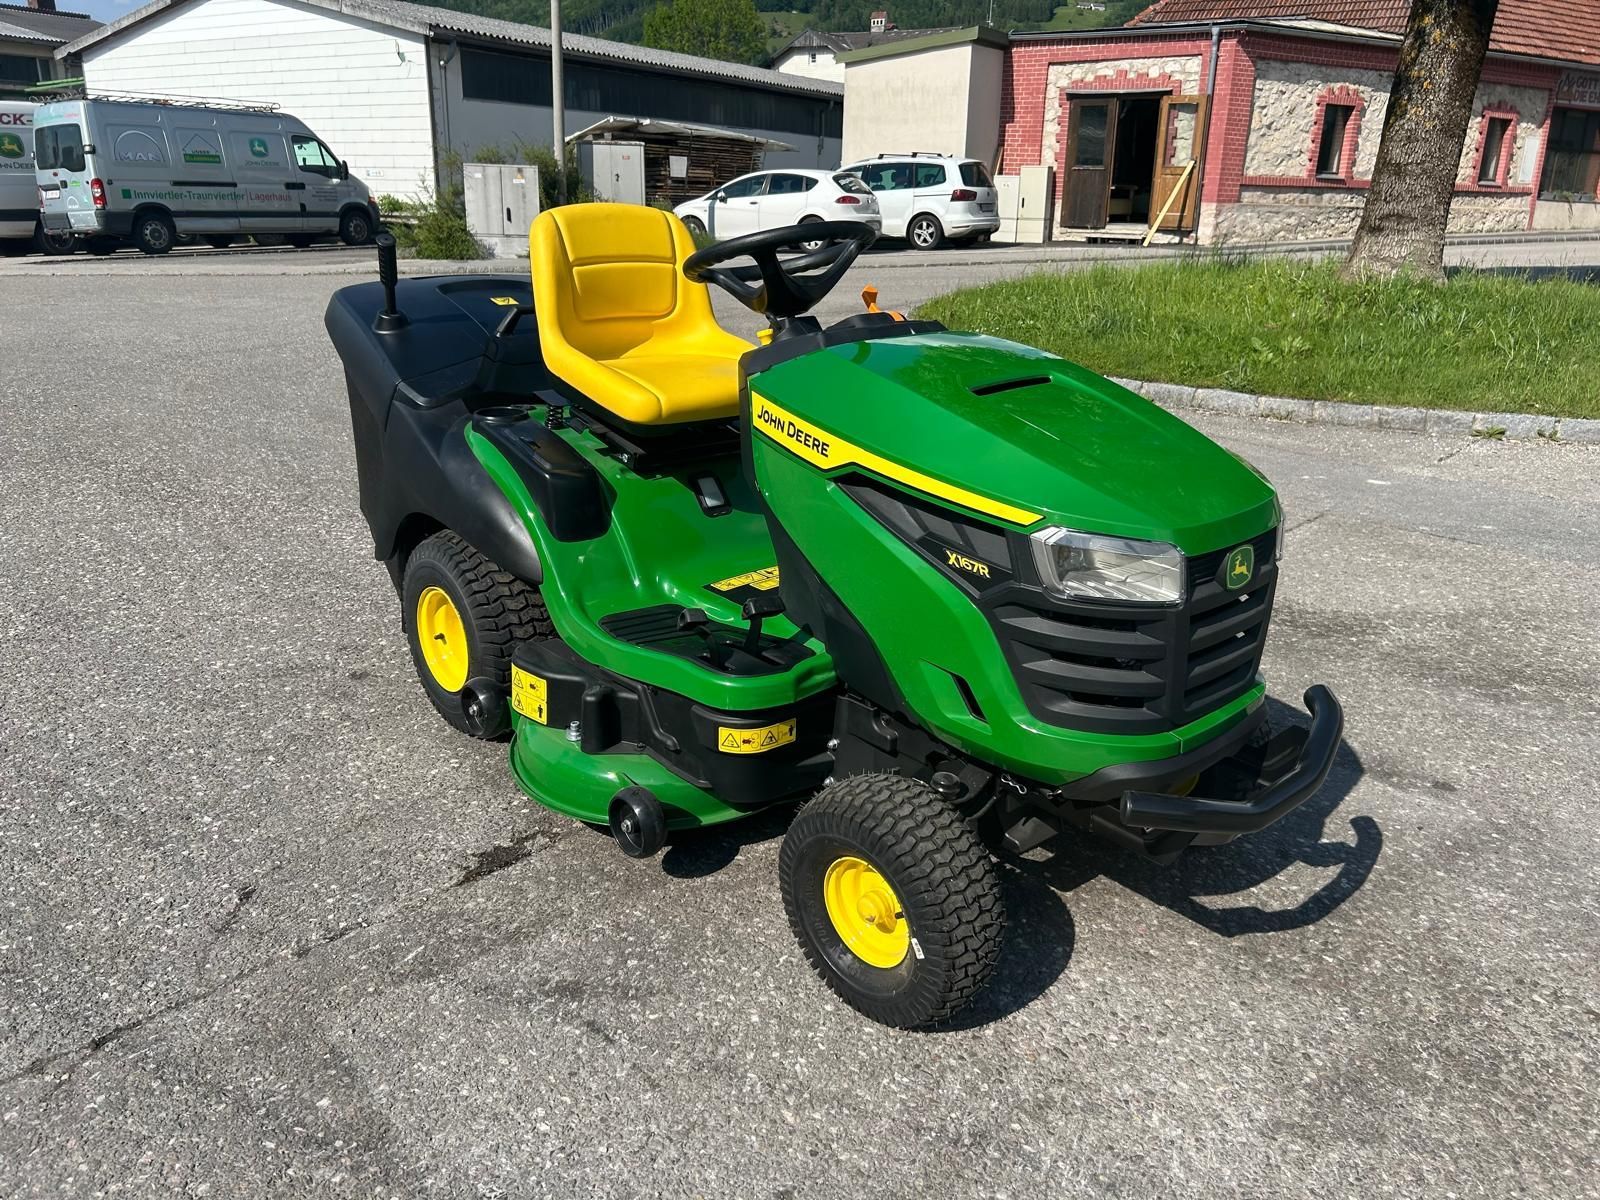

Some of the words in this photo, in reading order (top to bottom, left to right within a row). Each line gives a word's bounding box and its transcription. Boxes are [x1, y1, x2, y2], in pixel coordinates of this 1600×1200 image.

[133, 190, 245, 201] Innviertler-Traunviertler
[249, 192, 292, 203] Lagerhaus
[757, 405, 785, 434] JOHN
[787, 421, 830, 458] DEERE
[945, 550, 991, 578] X167R
